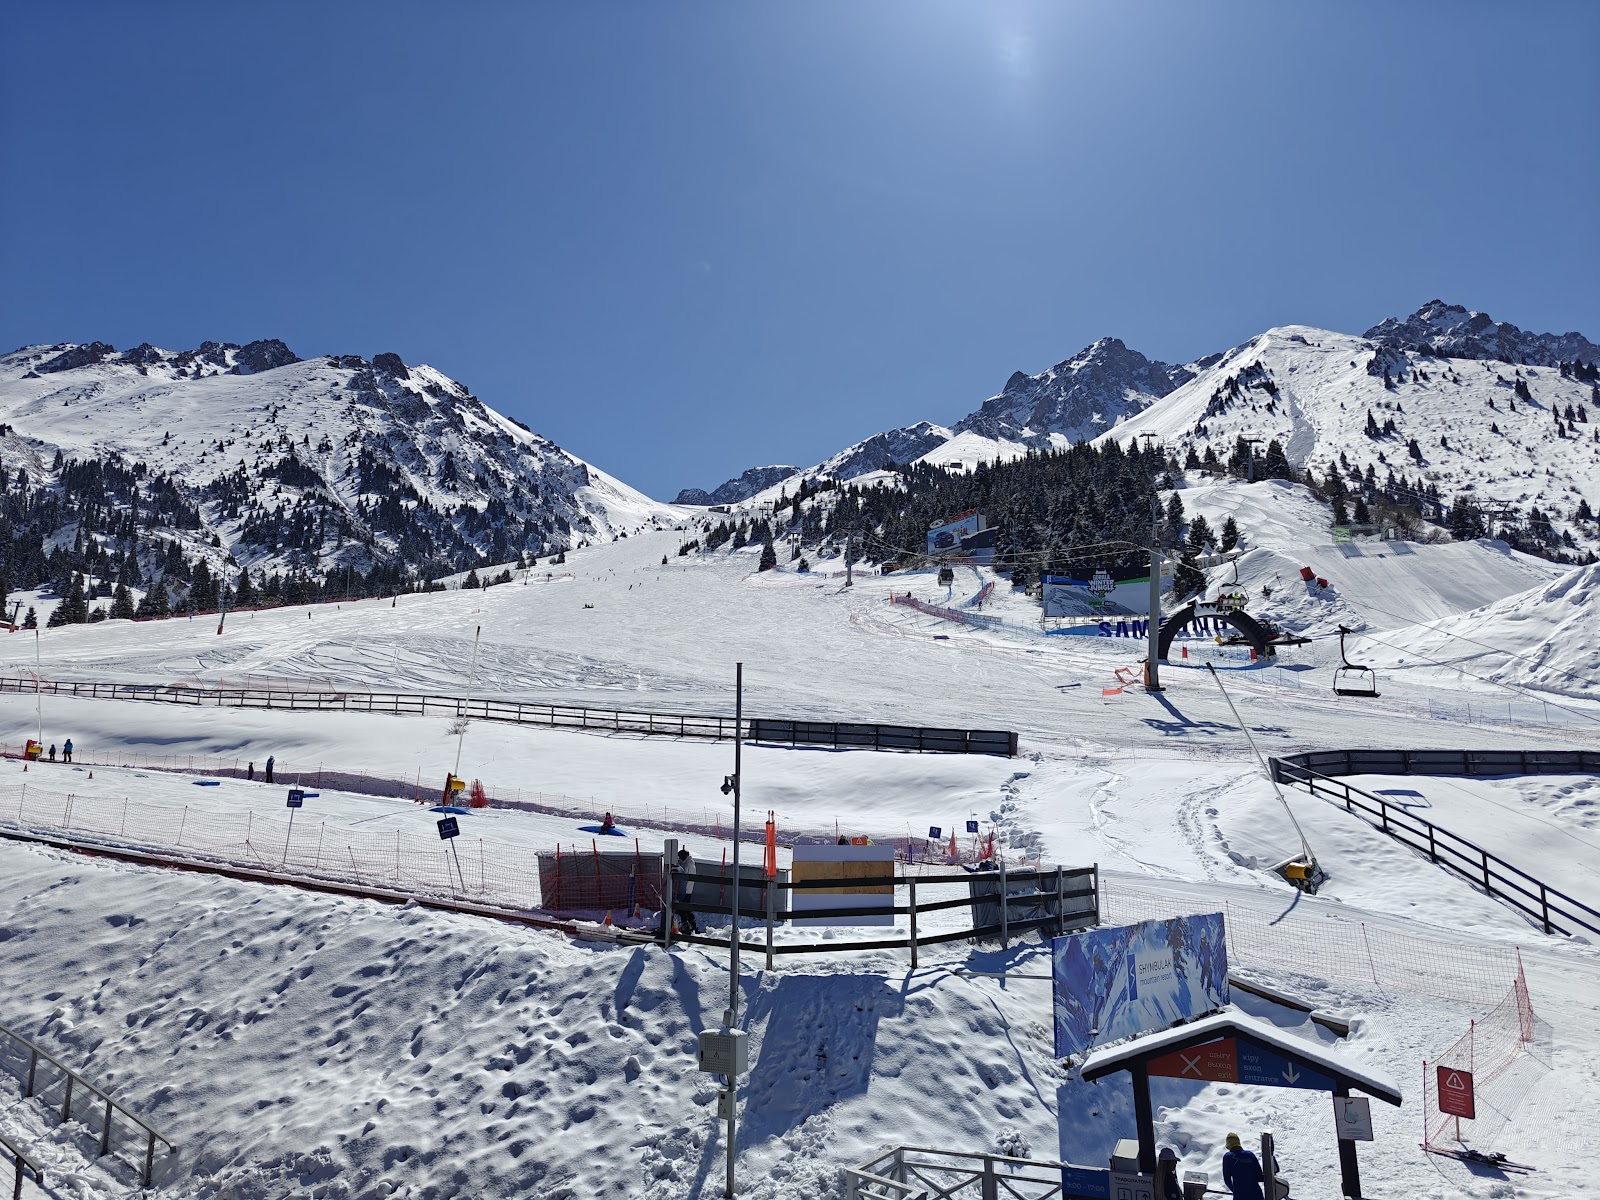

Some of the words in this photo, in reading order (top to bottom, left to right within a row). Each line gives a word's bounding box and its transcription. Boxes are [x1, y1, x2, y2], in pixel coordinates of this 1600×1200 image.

[1139, 958, 1172, 974] SHYMBULAK
[1140, 974, 1160, 986] mountain
[1161, 972, 1173, 980] resort
[1208, 1062, 1231, 1070] выход
[1244, 1064, 1262, 1072] вход
[1245, 1074, 1278, 1083] entrance
[1087, 1184, 1105, 1192] 17:00
